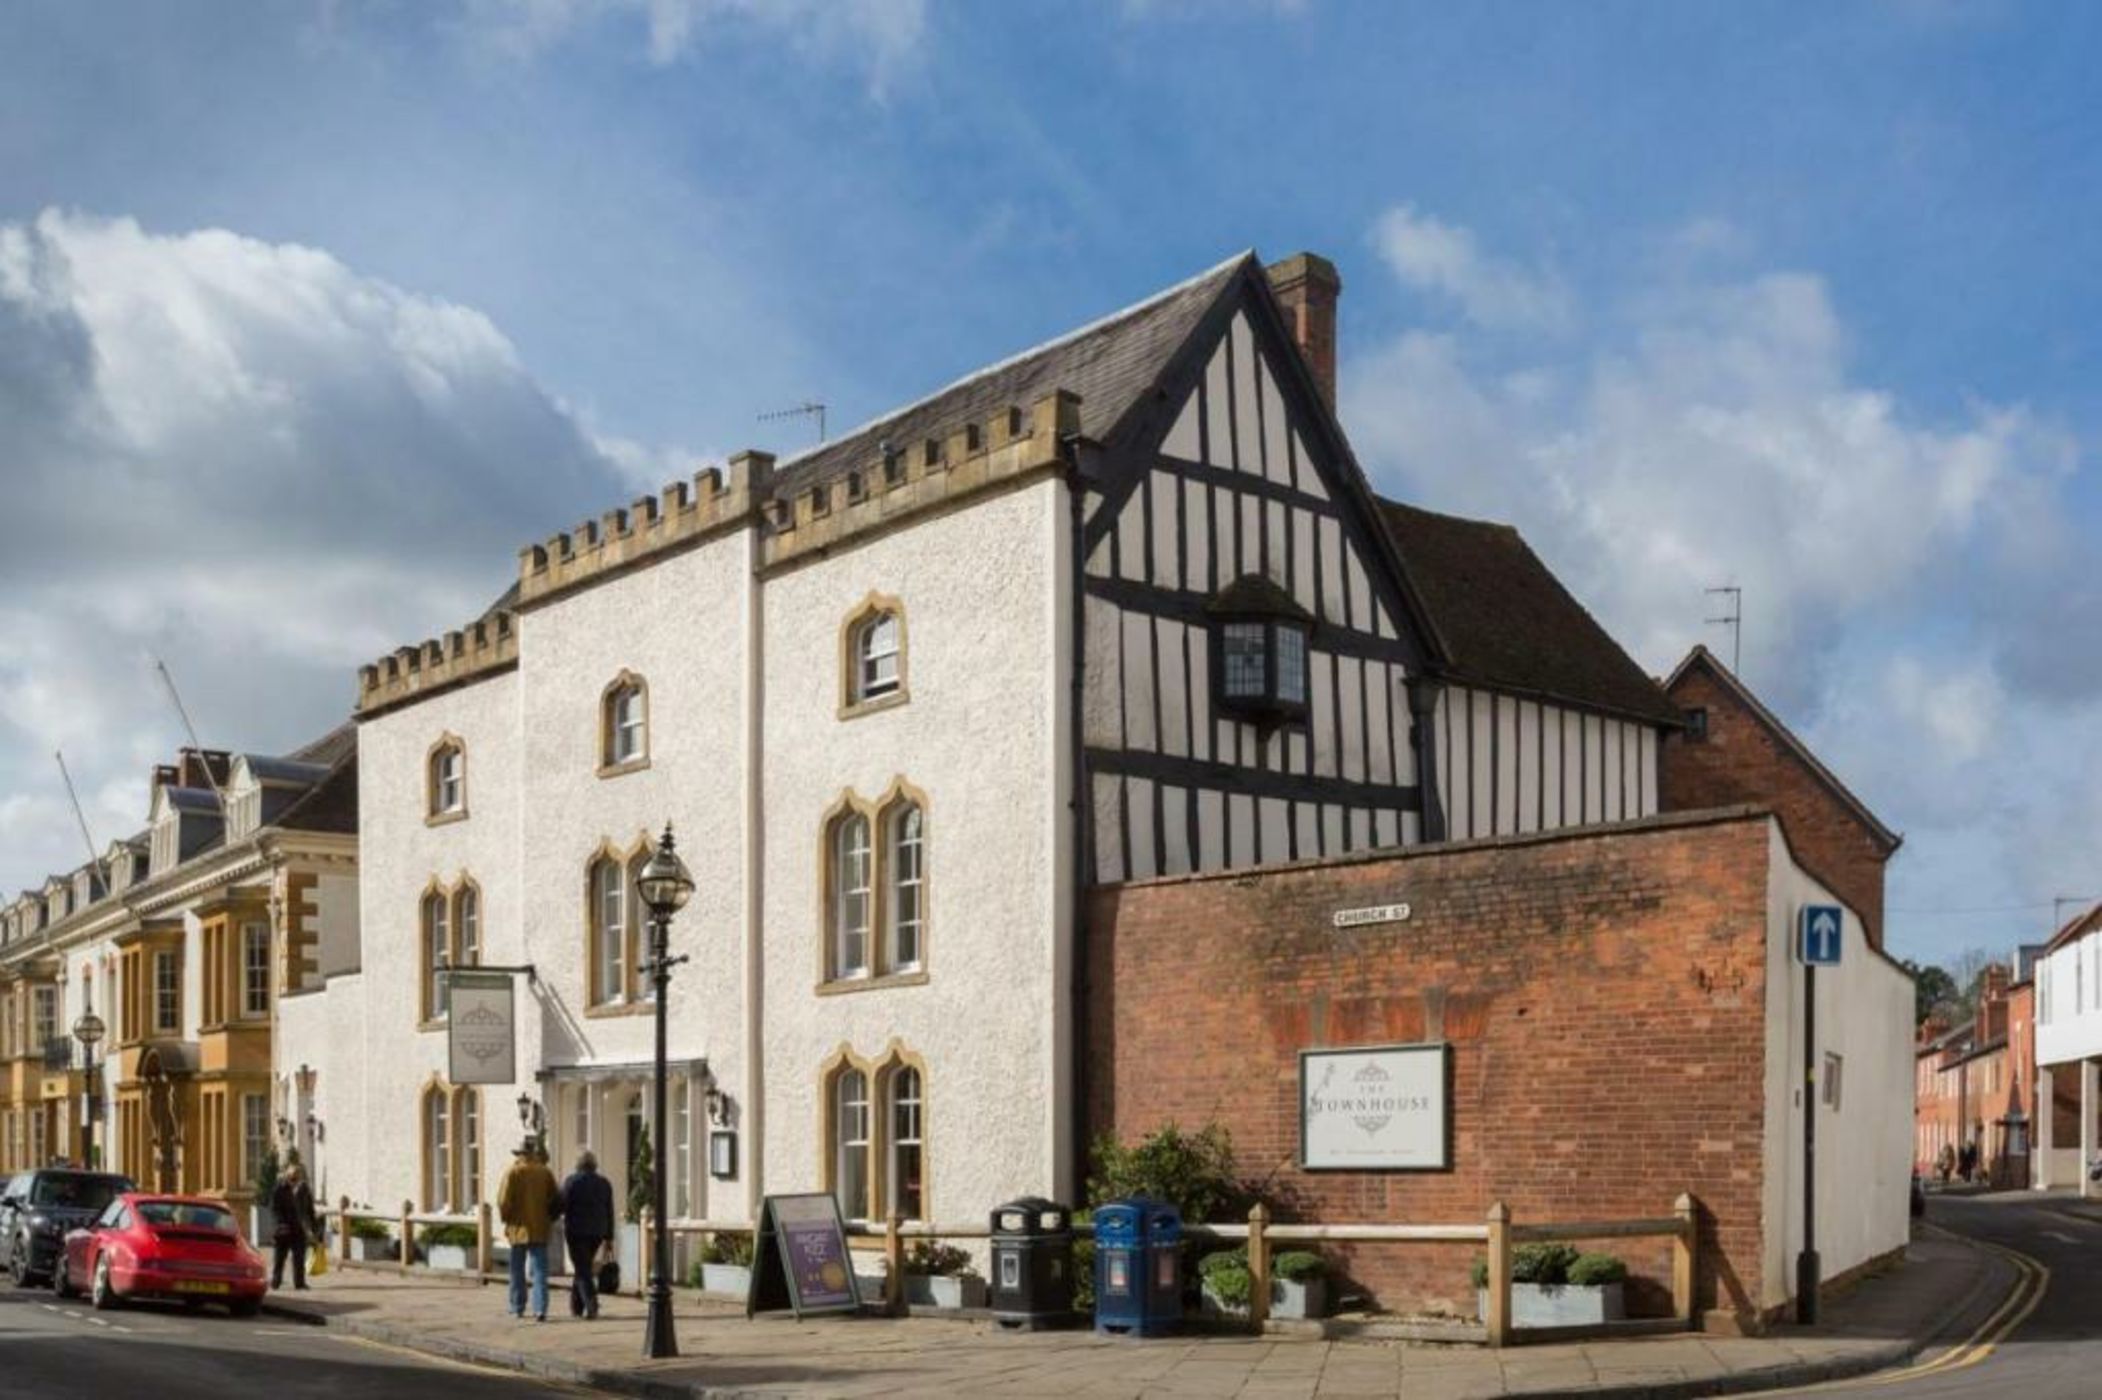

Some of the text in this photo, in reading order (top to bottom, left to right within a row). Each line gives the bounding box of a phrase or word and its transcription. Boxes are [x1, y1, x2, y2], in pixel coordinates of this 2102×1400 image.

[1337, 906, 1407, 923] CHURCH ST
[1360, 1084, 1385, 1093] THE
